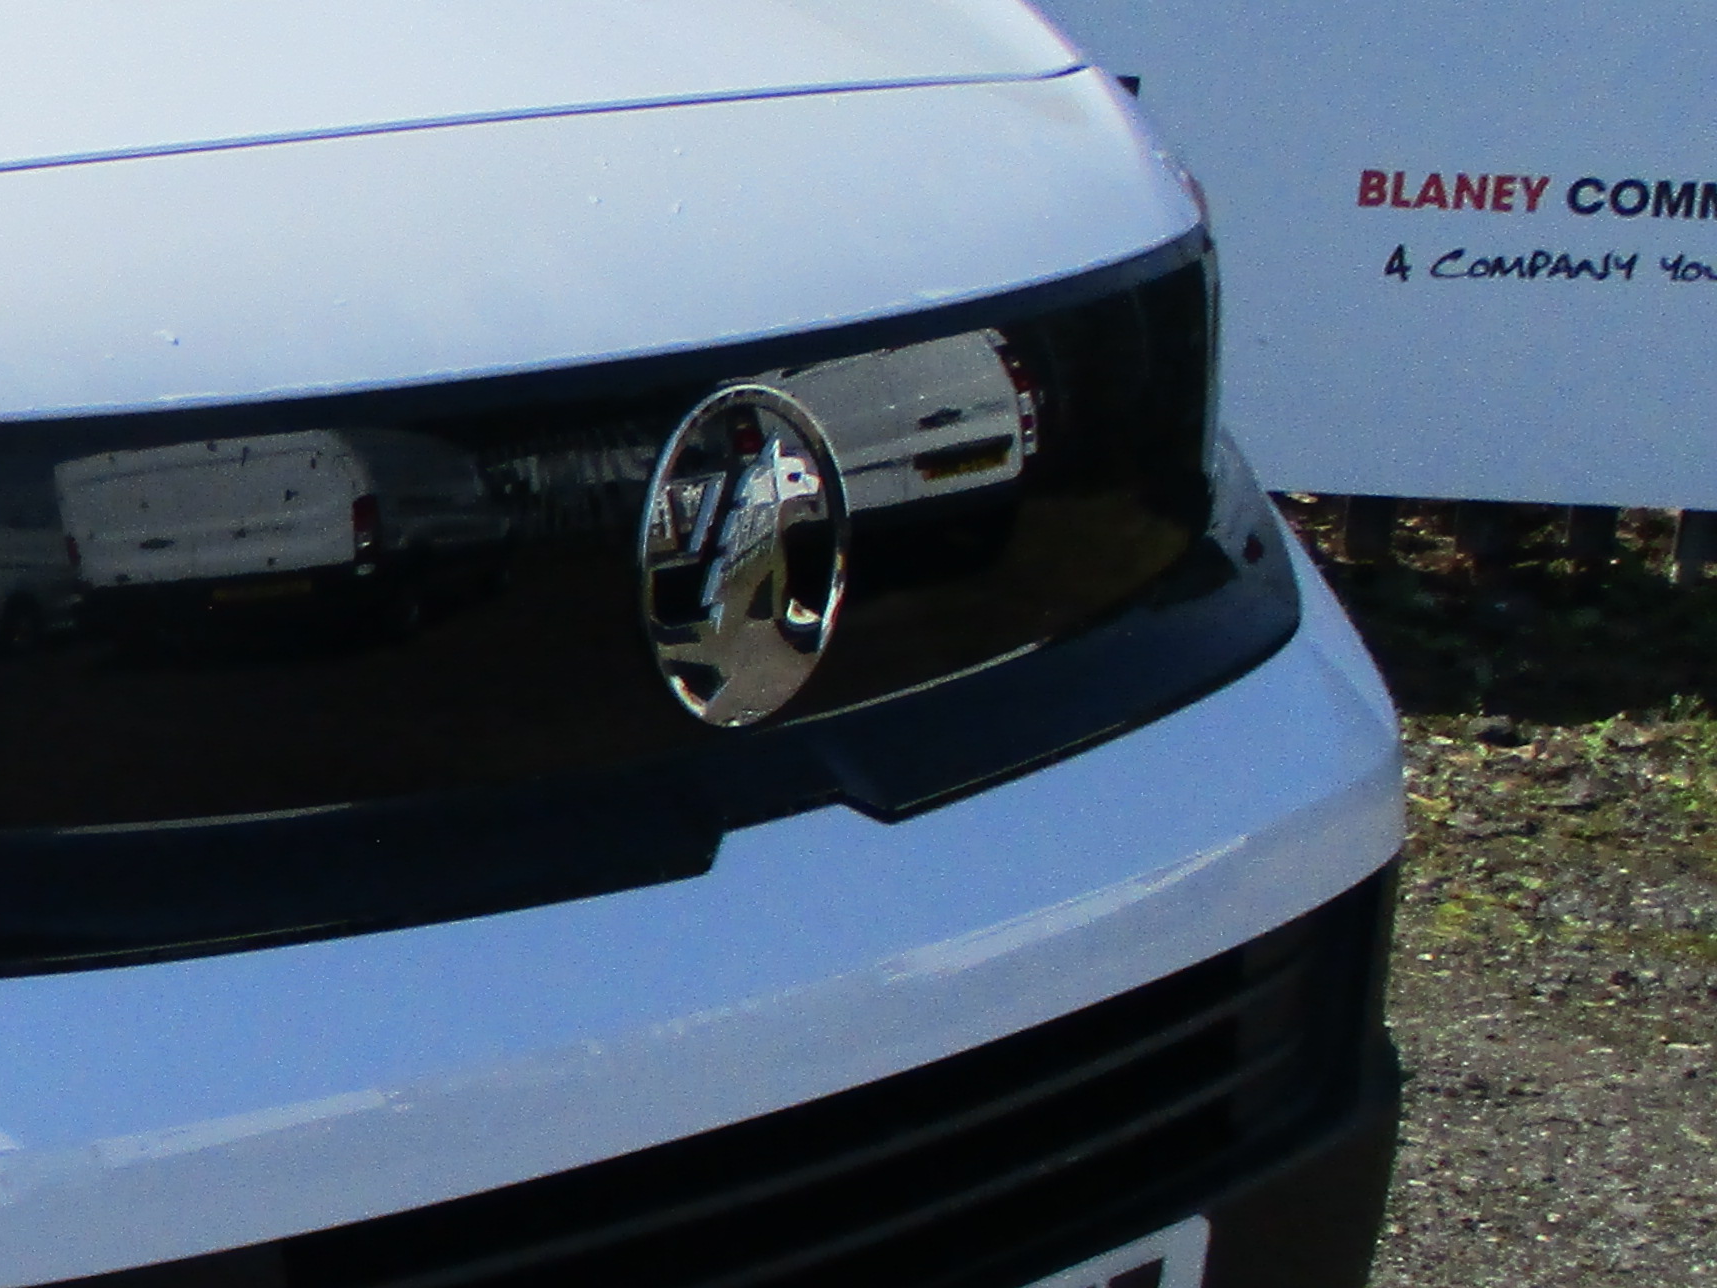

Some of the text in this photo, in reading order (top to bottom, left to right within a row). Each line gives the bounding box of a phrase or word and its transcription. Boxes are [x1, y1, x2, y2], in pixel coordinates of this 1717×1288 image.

[1358, 169, 1550, 213] BLANEY
[1384, 243, 1412, 282] A
[1430, 247, 1640, 282] COMPANY
